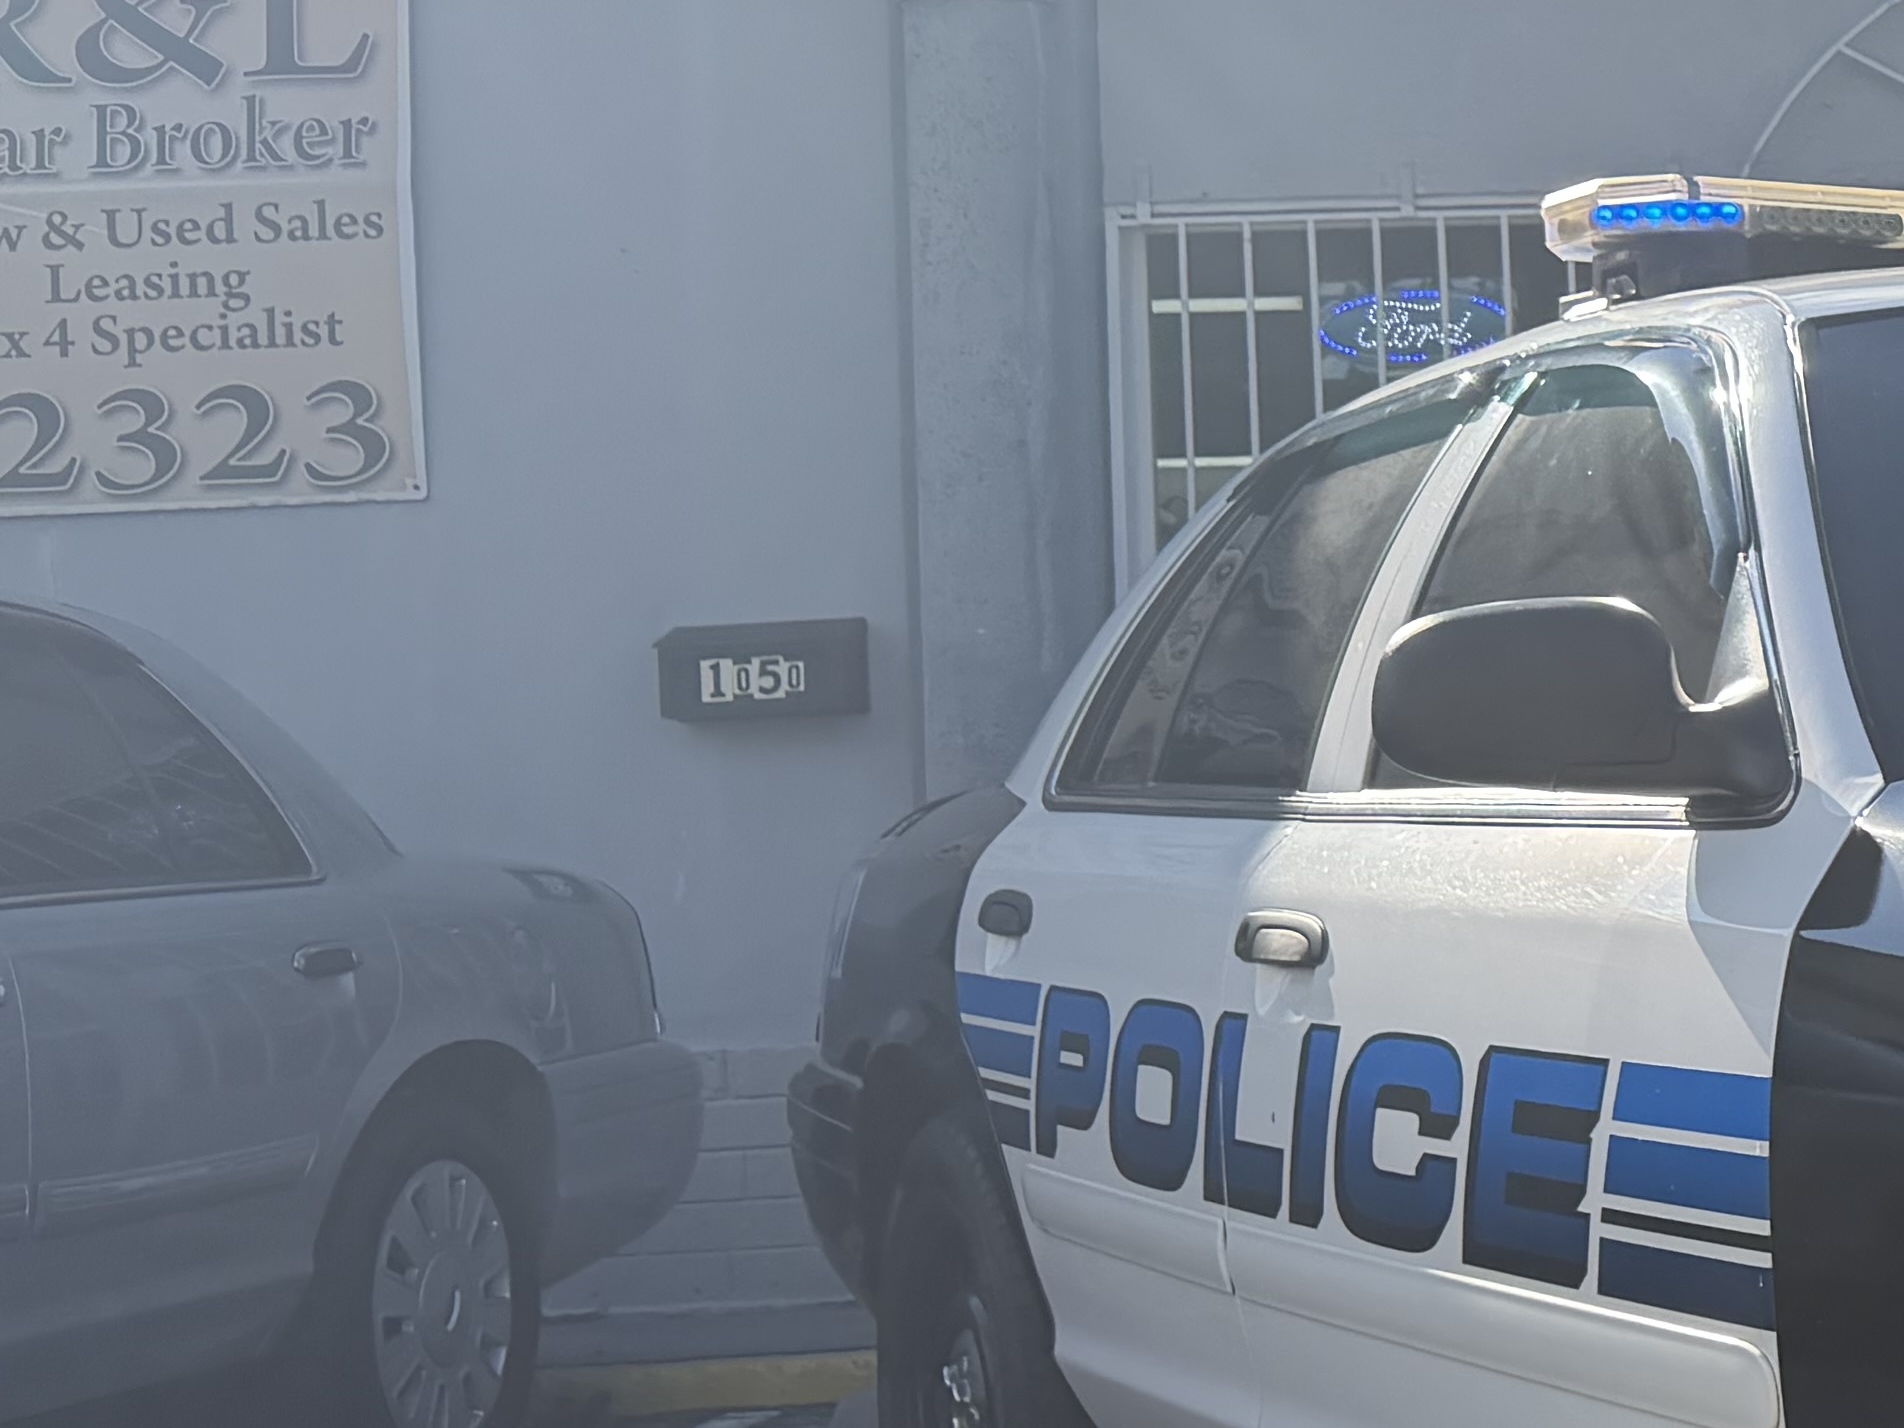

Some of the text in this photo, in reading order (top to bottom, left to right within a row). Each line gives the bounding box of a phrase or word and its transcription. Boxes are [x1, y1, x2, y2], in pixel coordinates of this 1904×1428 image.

[88, 93, 372, 172] Broker
[41, 210, 86, 253] &
[101, 201, 238, 249] Used
[253, 198, 385, 244] Sales
[44, 260, 252, 312] Leasing
[42, 317, 75, 358] 4
[91, 306, 345, 369] Specialist
[1357, 299, 1473, 349] Ford
[0, 378, 390, 495] 2323
[708, 657, 800, 699] 1050
[1035, 983, 1611, 1290] POLICE
